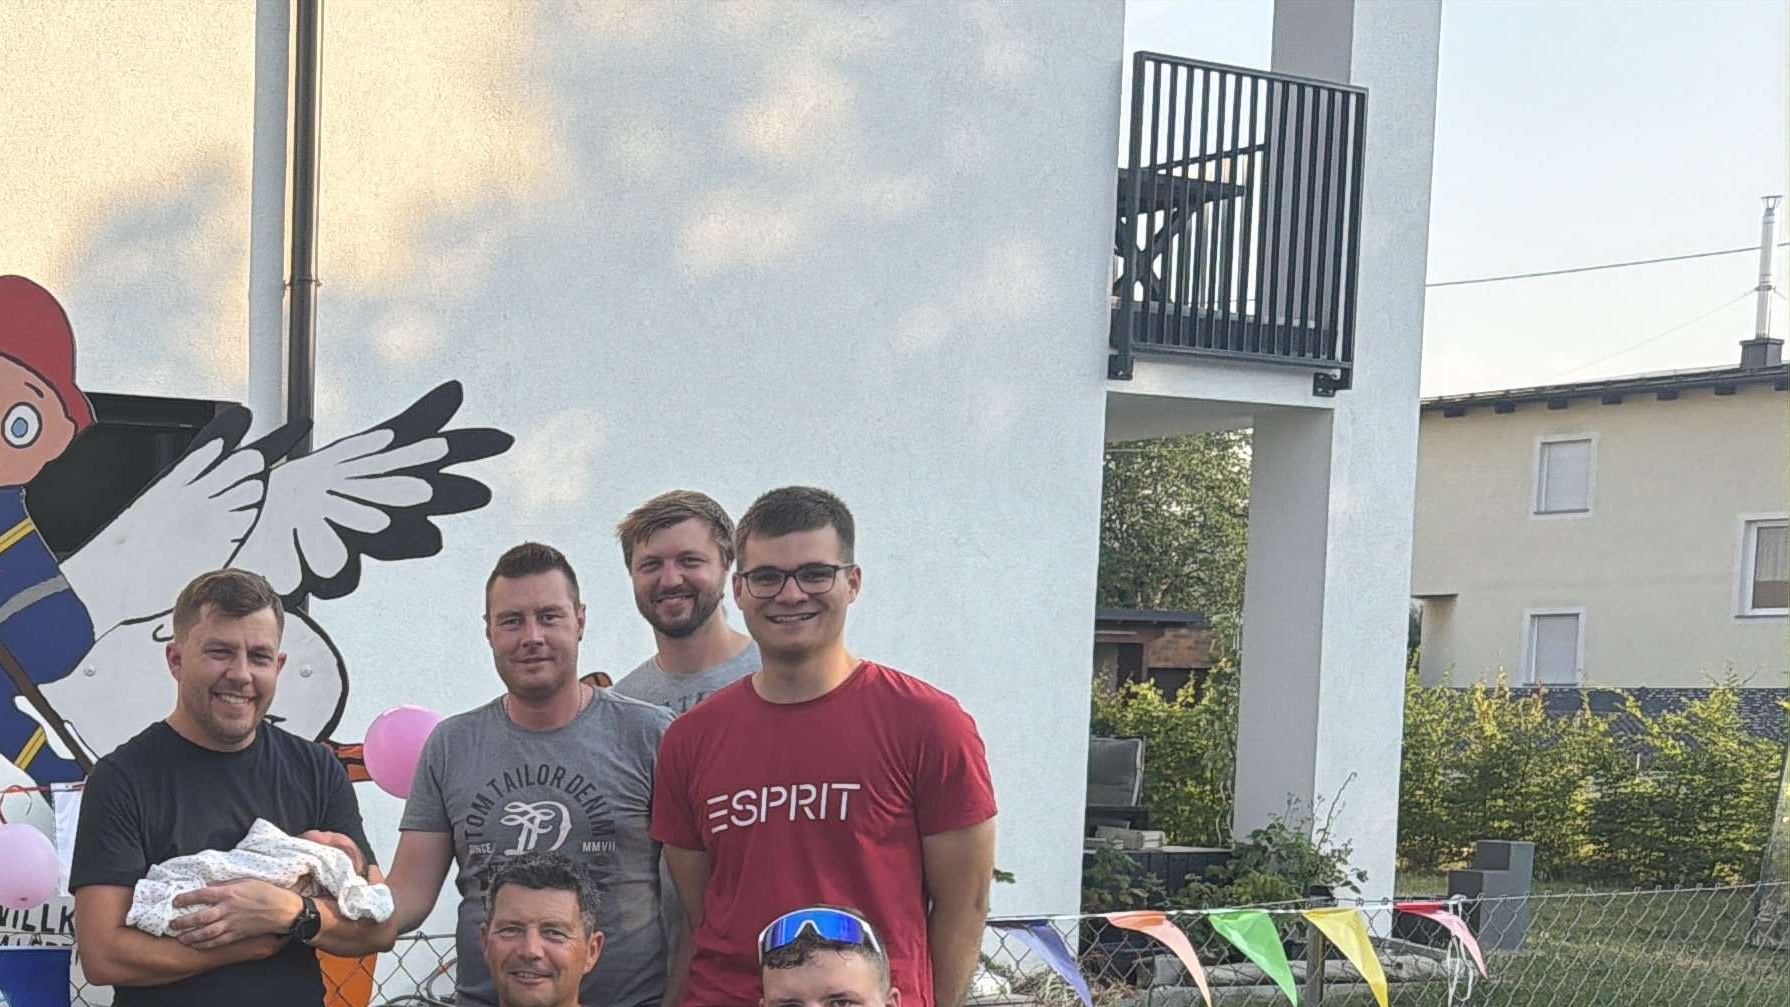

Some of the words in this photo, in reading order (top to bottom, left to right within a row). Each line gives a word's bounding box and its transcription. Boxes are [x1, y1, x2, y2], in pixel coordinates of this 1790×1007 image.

[464, 792, 495, 841] TOM
[486, 763, 566, 798] TAILOR
[564, 780, 616, 837] DENIM
[706, 783, 861, 834] ESPRIT
